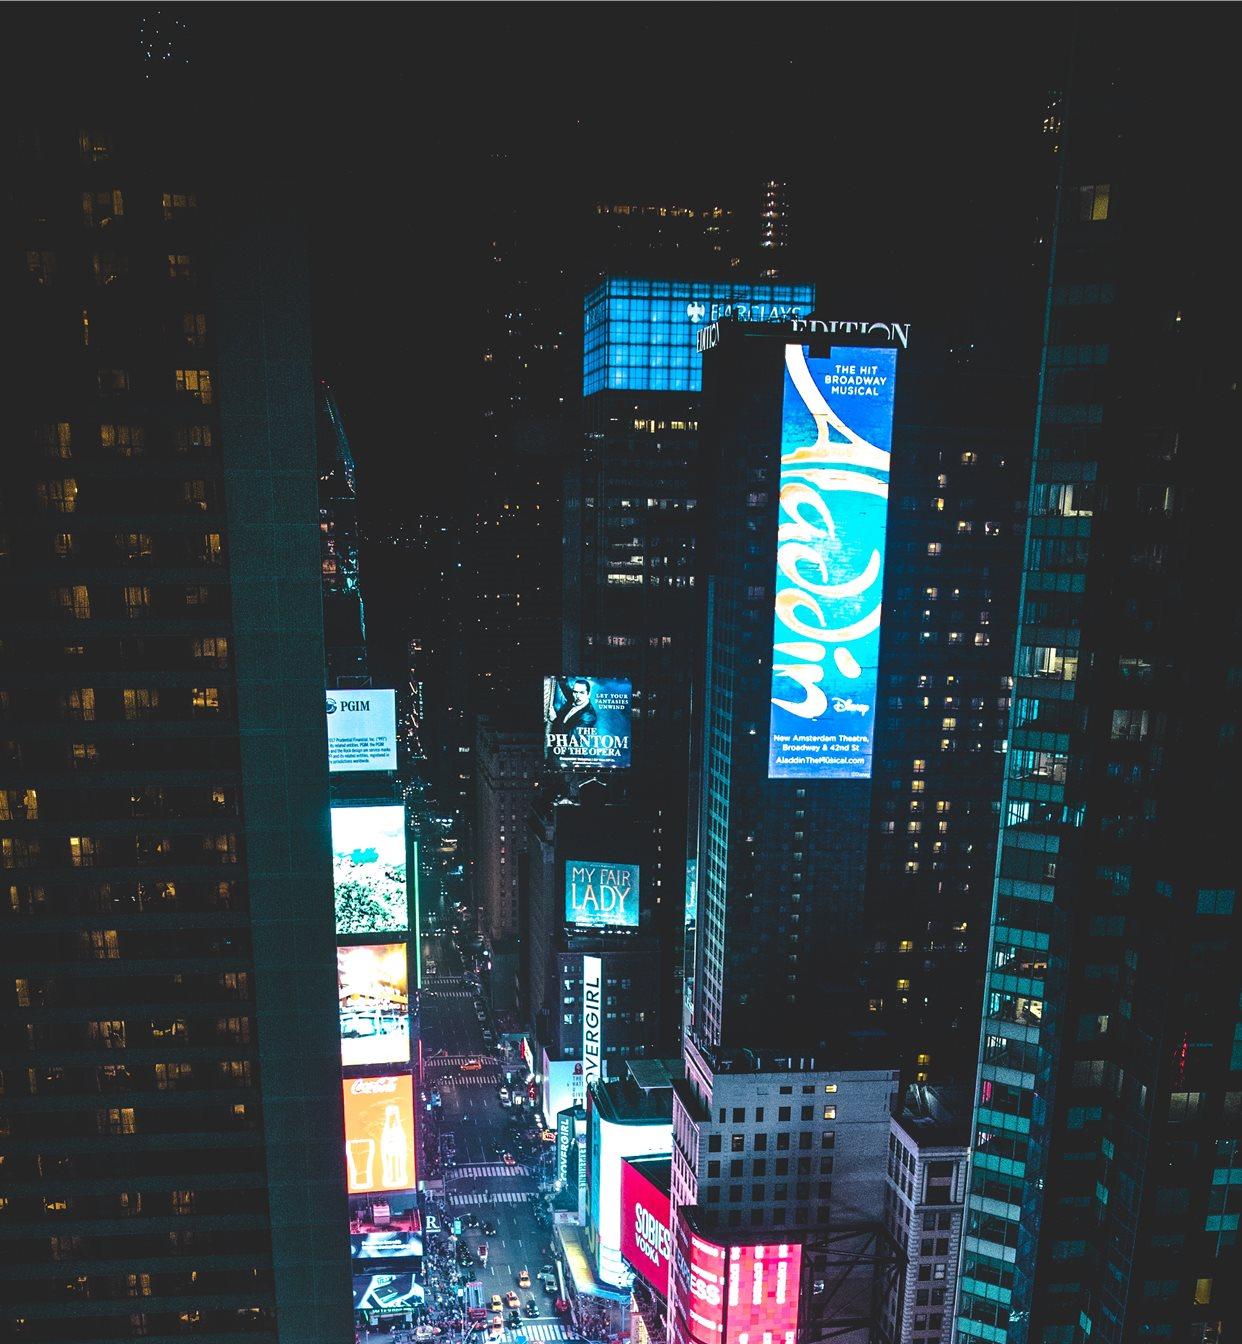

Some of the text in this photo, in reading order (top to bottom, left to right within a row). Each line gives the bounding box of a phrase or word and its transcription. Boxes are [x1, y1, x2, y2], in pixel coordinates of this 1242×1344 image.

[836, 364, 878, 376] THE HIT
[824, 375, 888, 387] BROADWAY
[831, 386, 879, 397] MUSICAL
[340, 700, 370, 712] PGIM
[831, 697, 870, 717] Disney
[576, 727, 597, 735] THE
[773, 734, 791, 742] New
[793, 734, 837, 742] Amsterdam
[546, 733, 629, 749] PHANTOM
[782, 744, 820, 752] Broadway
[851, 744, 860, 752] St
[553, 746, 621, 757] OF THE OPERA
[572, 866, 631, 887] MY FAIR
[571, 882, 631, 913] LADY
[585, 977, 600, 1084] OVERGIRL
[560, 1119, 569, 1182] COVERGIRL
[635, 1202, 671, 1261] SOBIES
[635, 1232, 660, 1267] VODKA
